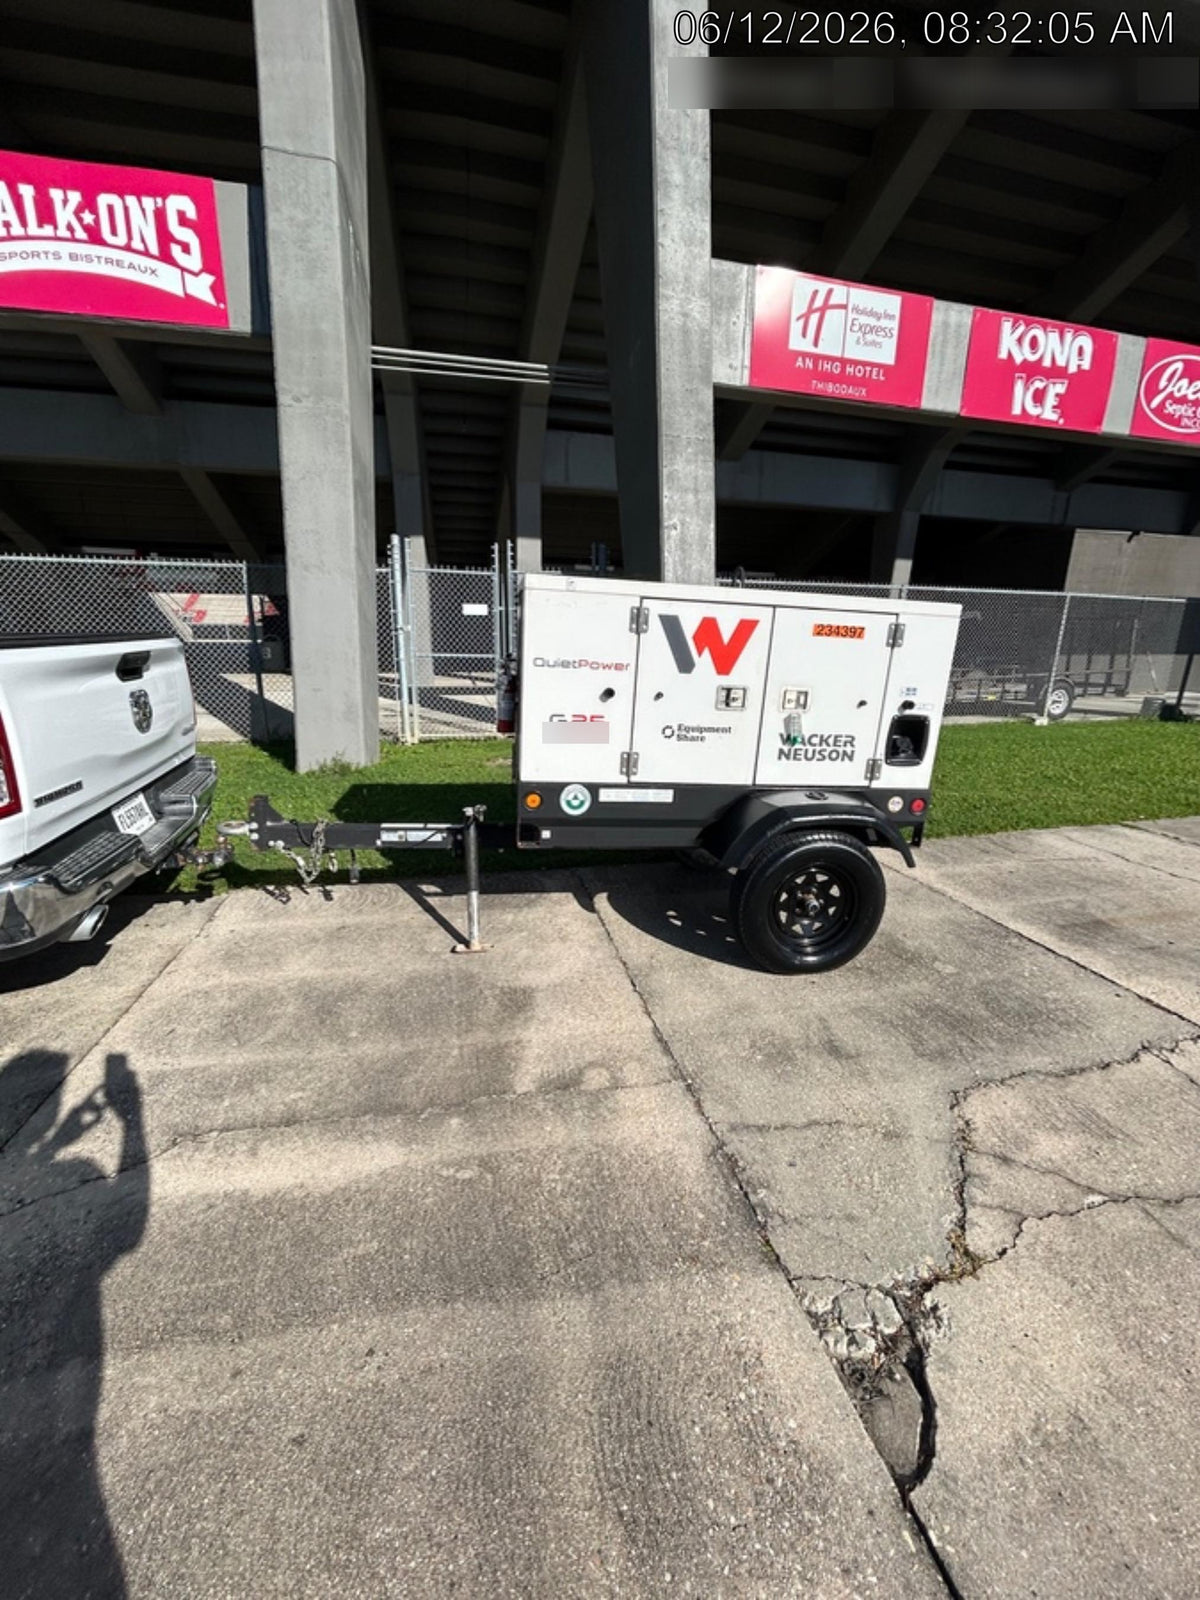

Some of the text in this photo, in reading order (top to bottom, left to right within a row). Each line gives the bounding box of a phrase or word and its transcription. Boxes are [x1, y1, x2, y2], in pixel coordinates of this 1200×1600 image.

[0, 249, 159, 278] SPORTS BISTREAUX
[850, 303, 882, 321] Holiday
[849, 318, 895, 339] Express
[997, 316, 1094, 374] KONA
[795, 355, 886, 381] AN IHG HOTEL
[811, 380, 868, 397] THIBODAUX
[816, 623, 865, 639] 234397
[532, 656, 631, 672] QuietPower
[676, 723, 732, 735] Equipment
[676, 733, 706, 743] Share
[777, 747, 855, 762] NEUSON
